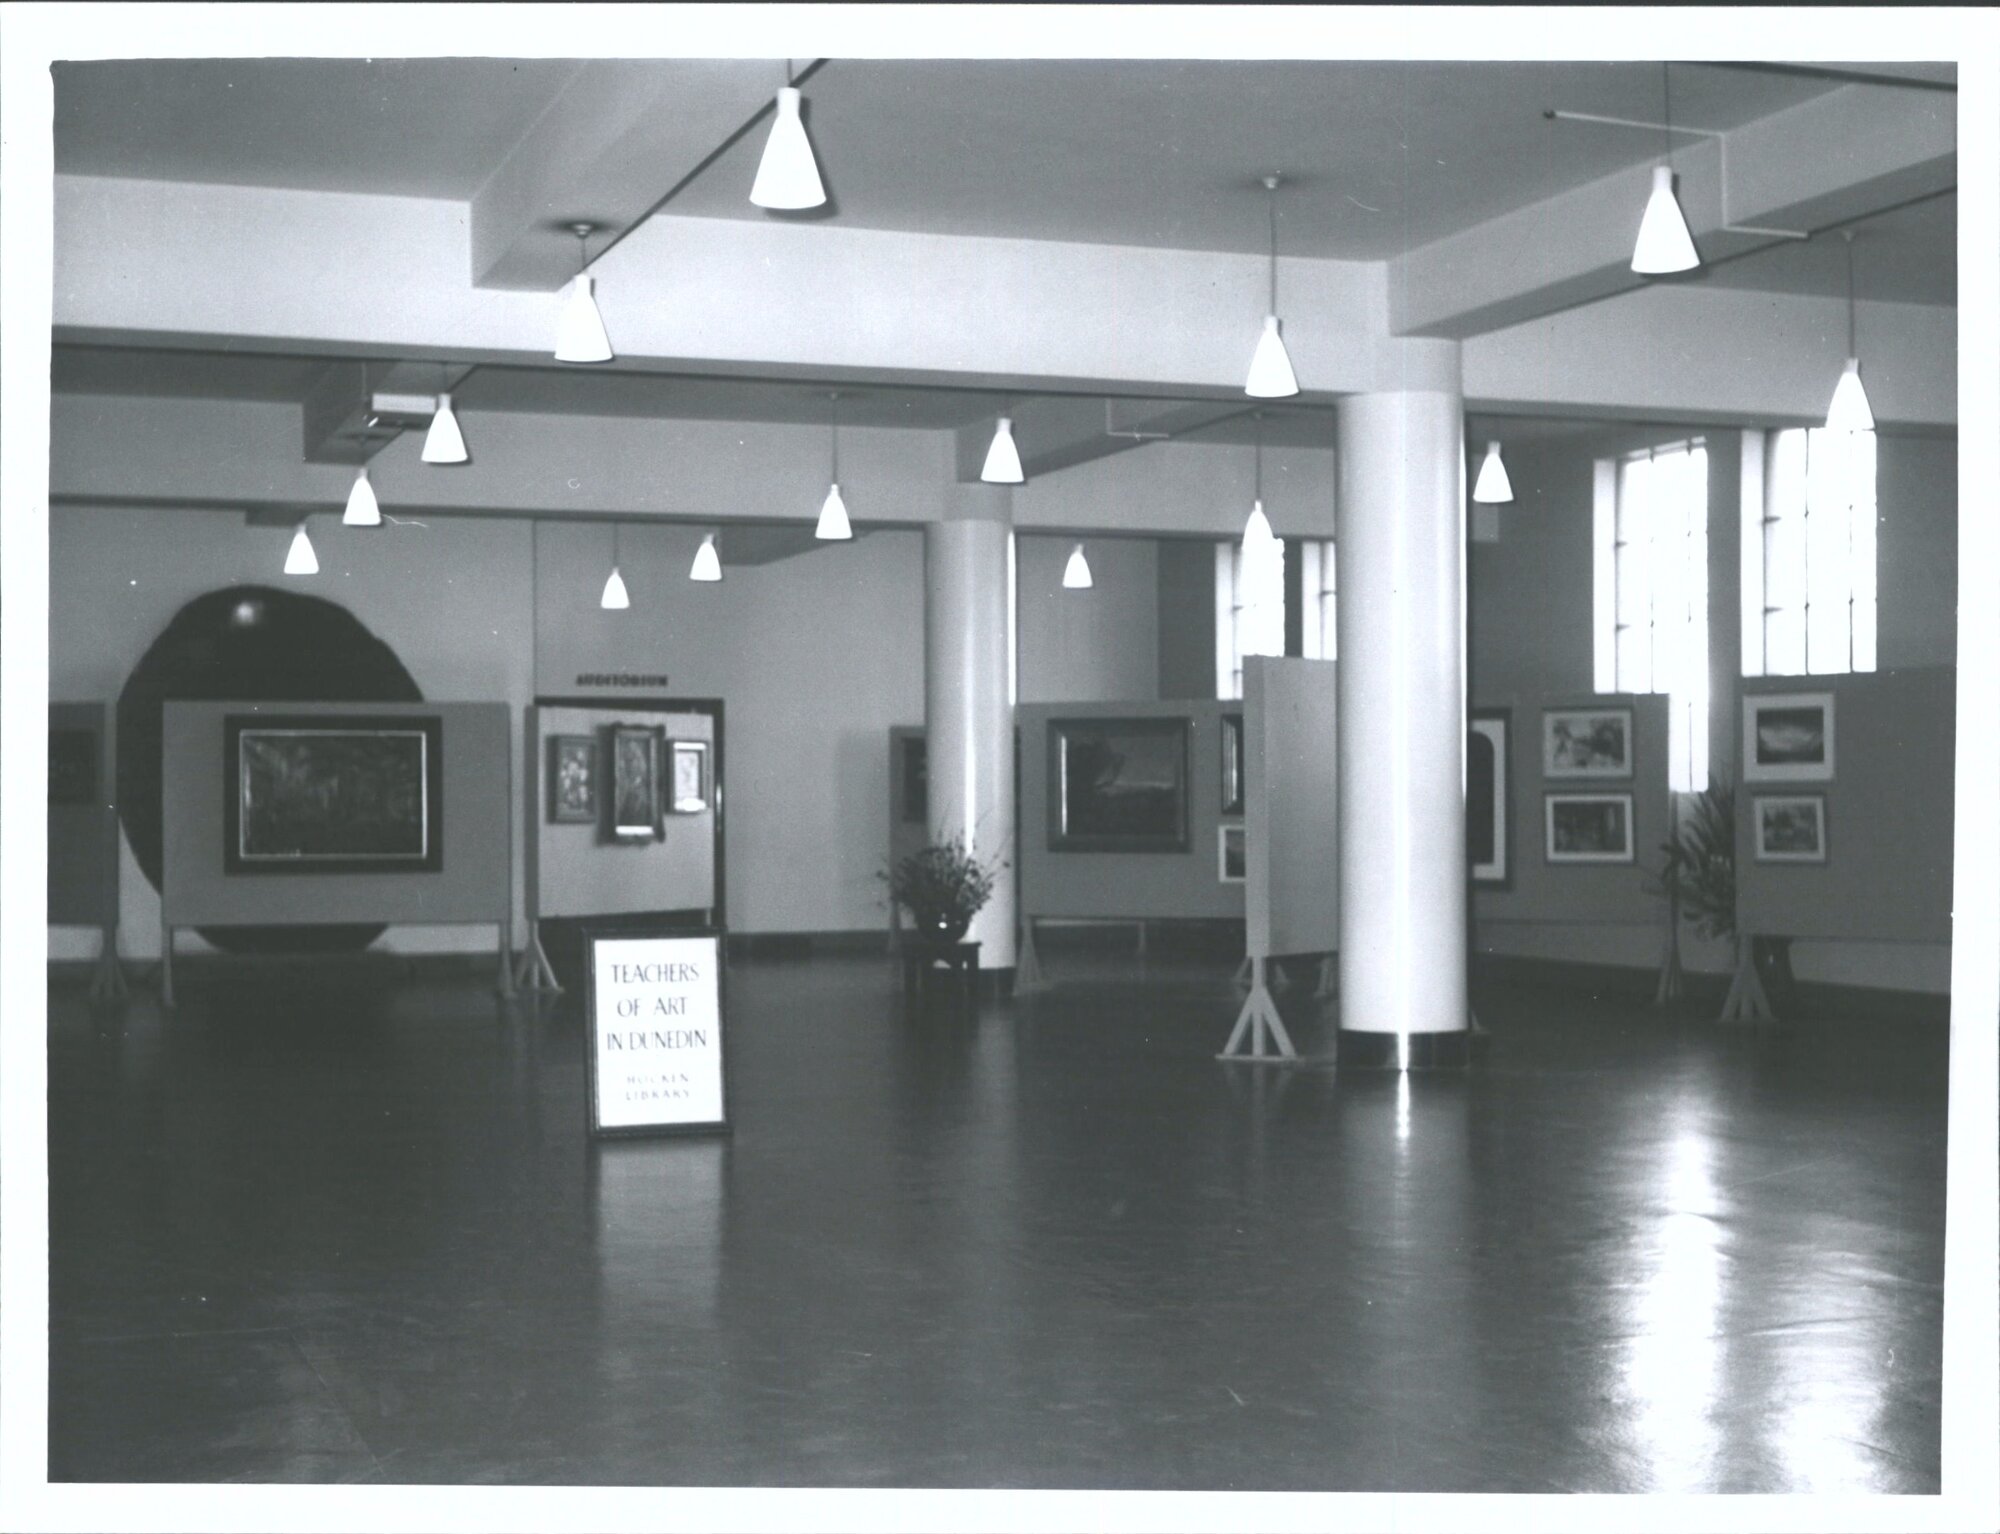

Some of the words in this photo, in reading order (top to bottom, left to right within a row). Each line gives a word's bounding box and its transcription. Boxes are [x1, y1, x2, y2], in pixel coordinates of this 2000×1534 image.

[611, 963, 699, 983] TEACHERS
[617, 998, 641, 1017] OF
[654, 996, 687, 1015] ART
[607, 1031, 622, 1050] IN
[630, 1029, 706, 1050] DUNEDIN
[626, 1089, 689, 1101] LIBRARY
